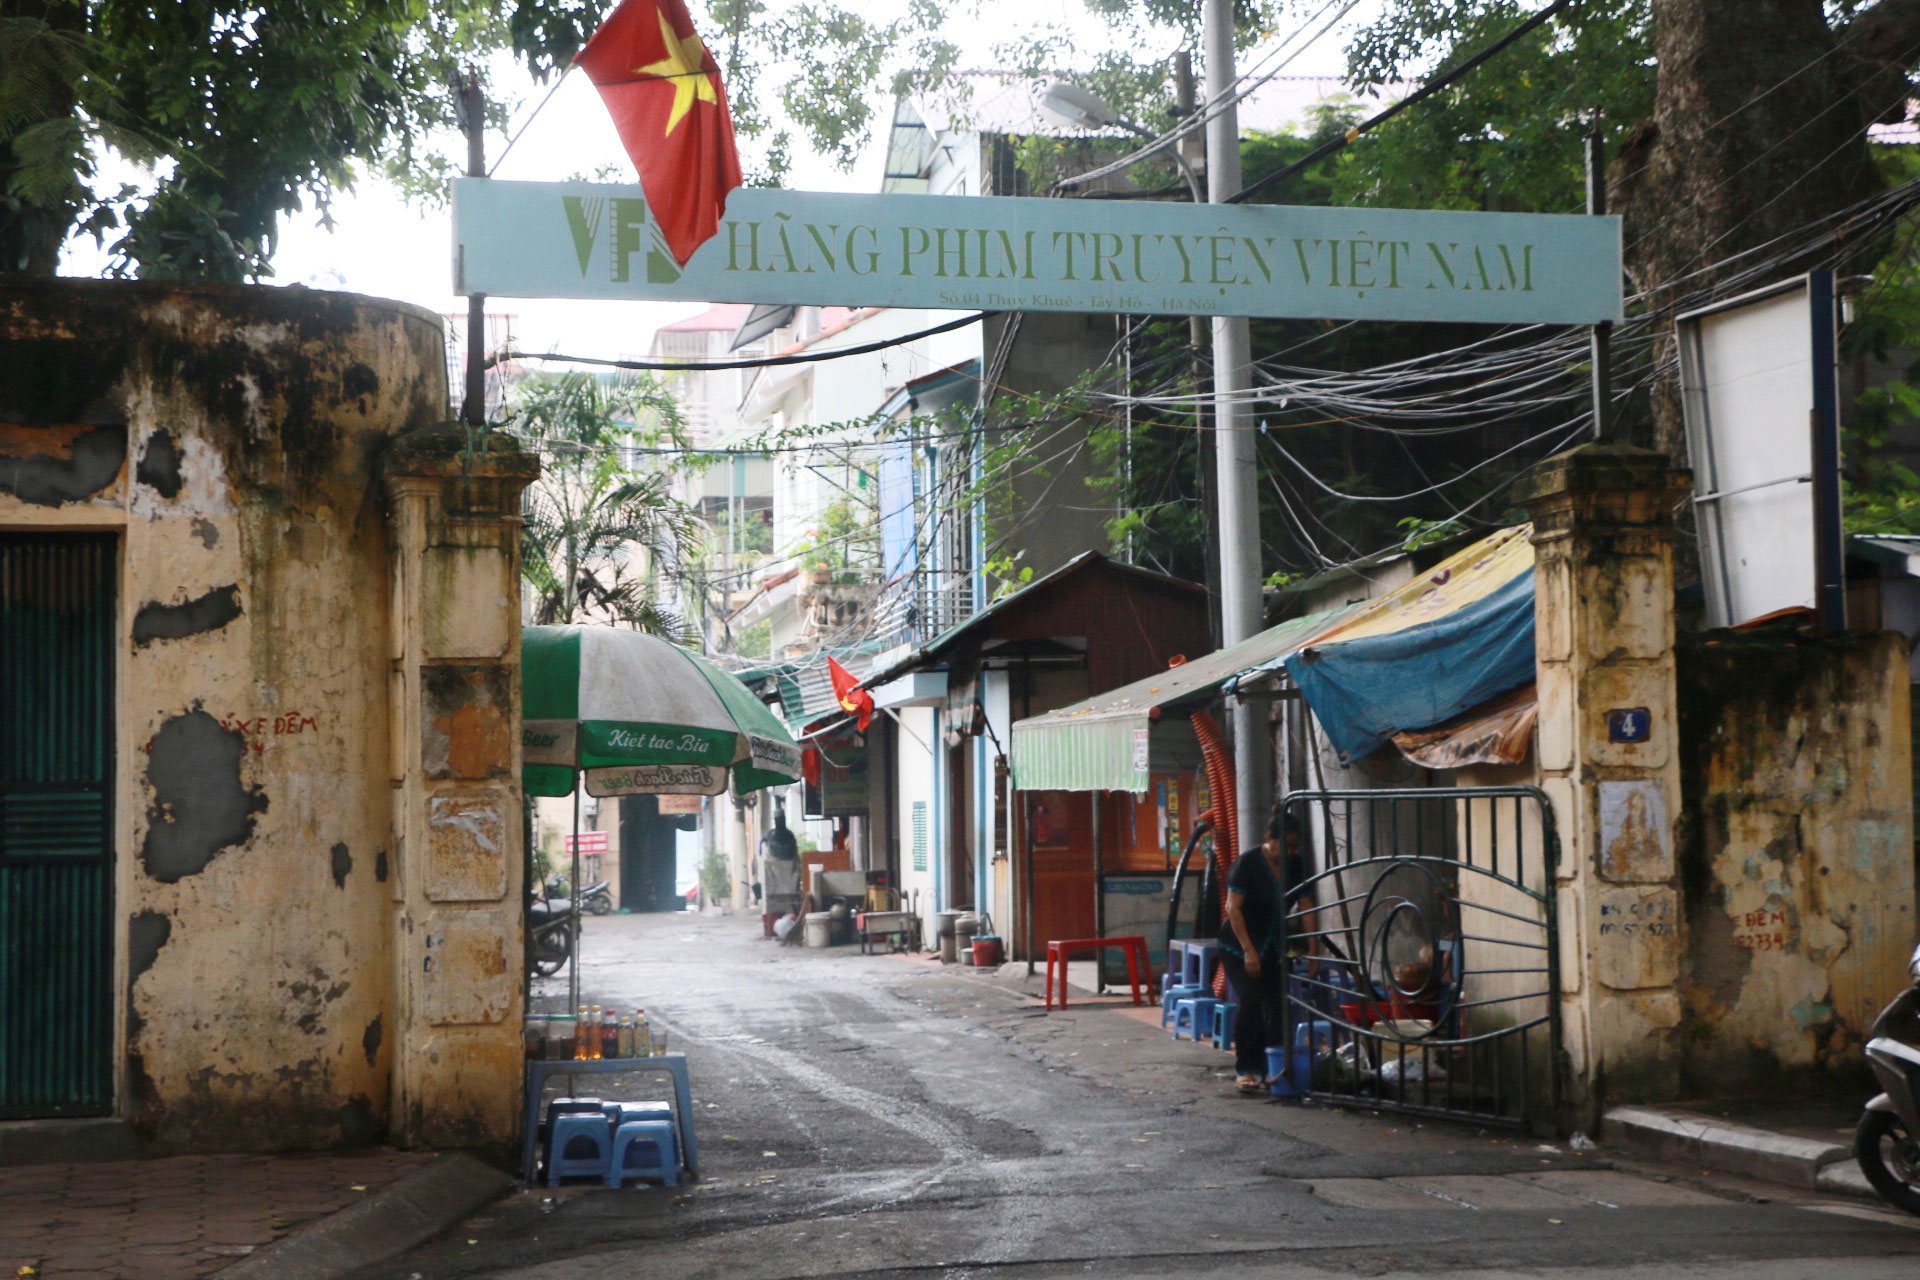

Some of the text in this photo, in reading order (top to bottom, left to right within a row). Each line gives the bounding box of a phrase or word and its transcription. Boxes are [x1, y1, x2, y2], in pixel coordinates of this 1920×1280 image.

[725, 211, 1536, 298] HÃNG PHIM TRUYỆN VIỆT NAM
[963, 293, 980, 304] 04
[273, 711, 318, 735] ĐÊM
[1621, 713, 1637, 737] 4
[677, 734, 710, 753] Bia
